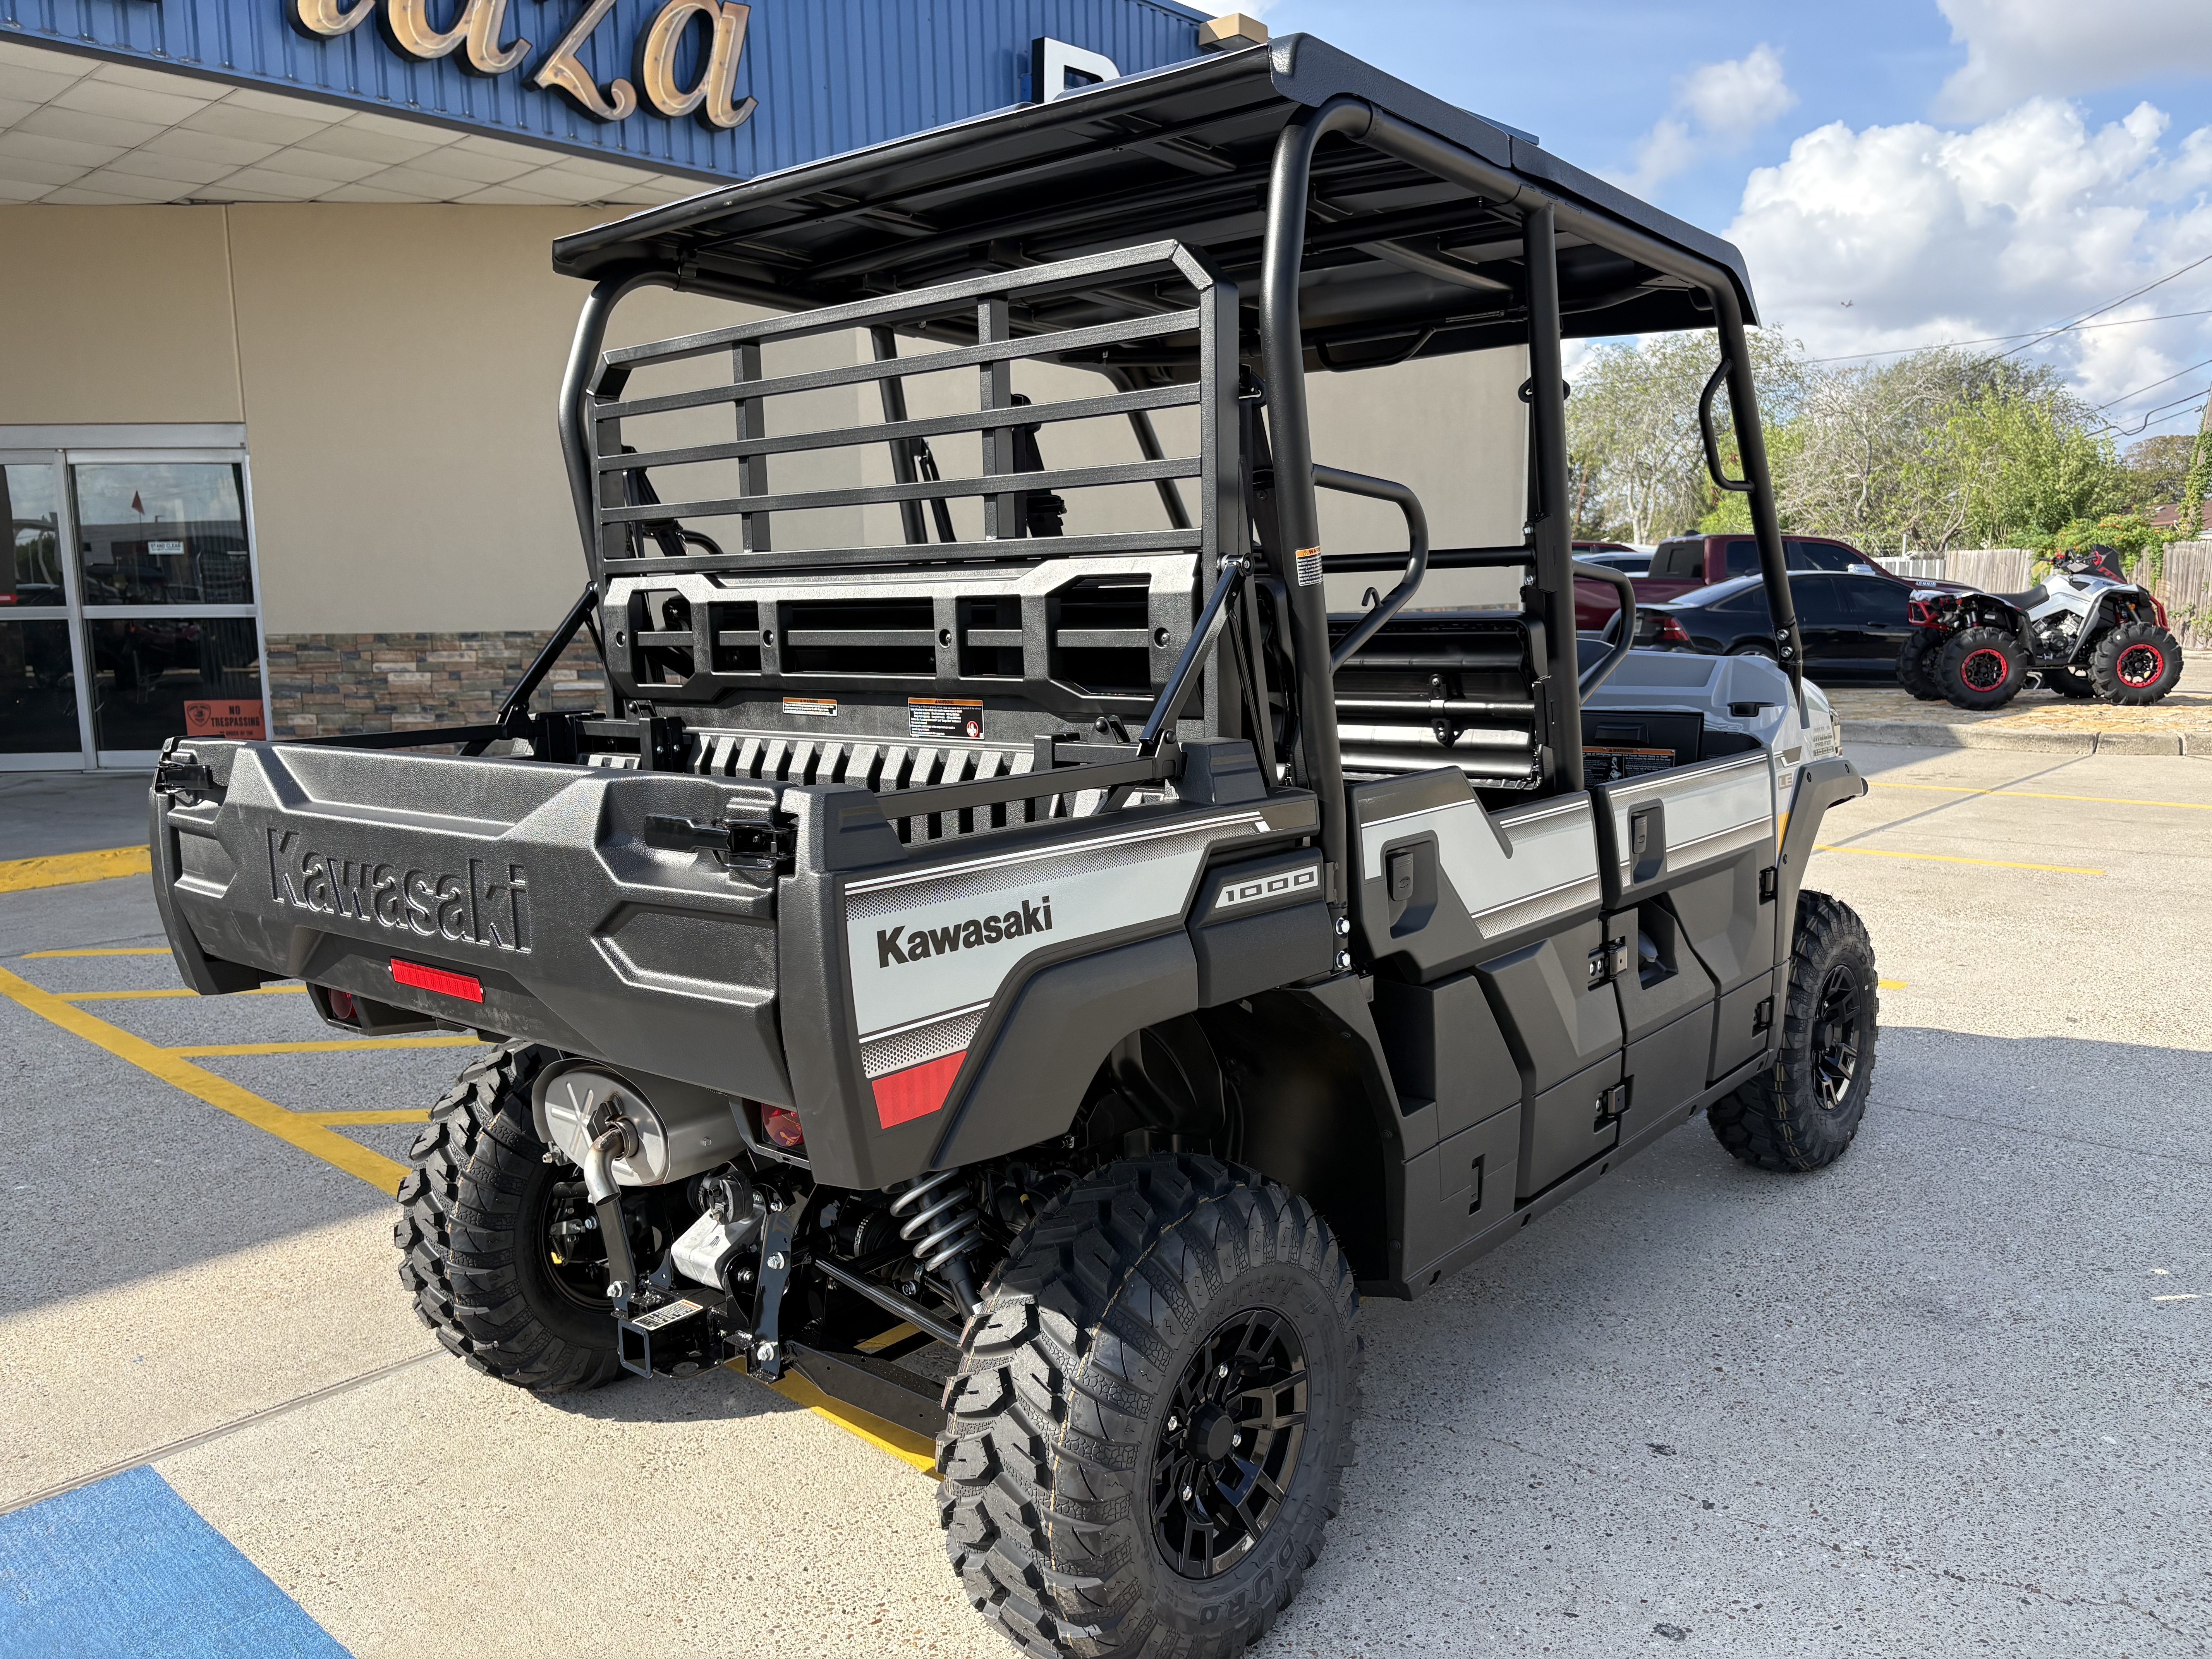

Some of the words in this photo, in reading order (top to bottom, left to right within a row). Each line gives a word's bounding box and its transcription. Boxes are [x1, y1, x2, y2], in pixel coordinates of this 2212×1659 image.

[211, 717, 260, 727] TRESPASSING
[229, 705, 240, 715] NO
[1779, 775, 1792, 788] LE
[267, 827, 532, 954] Kawasaki
[1225, 869, 1315, 902] 1000
[876, 895, 1053, 968] Kawasaki
[1199, 1534, 1296, 1622] DURO
